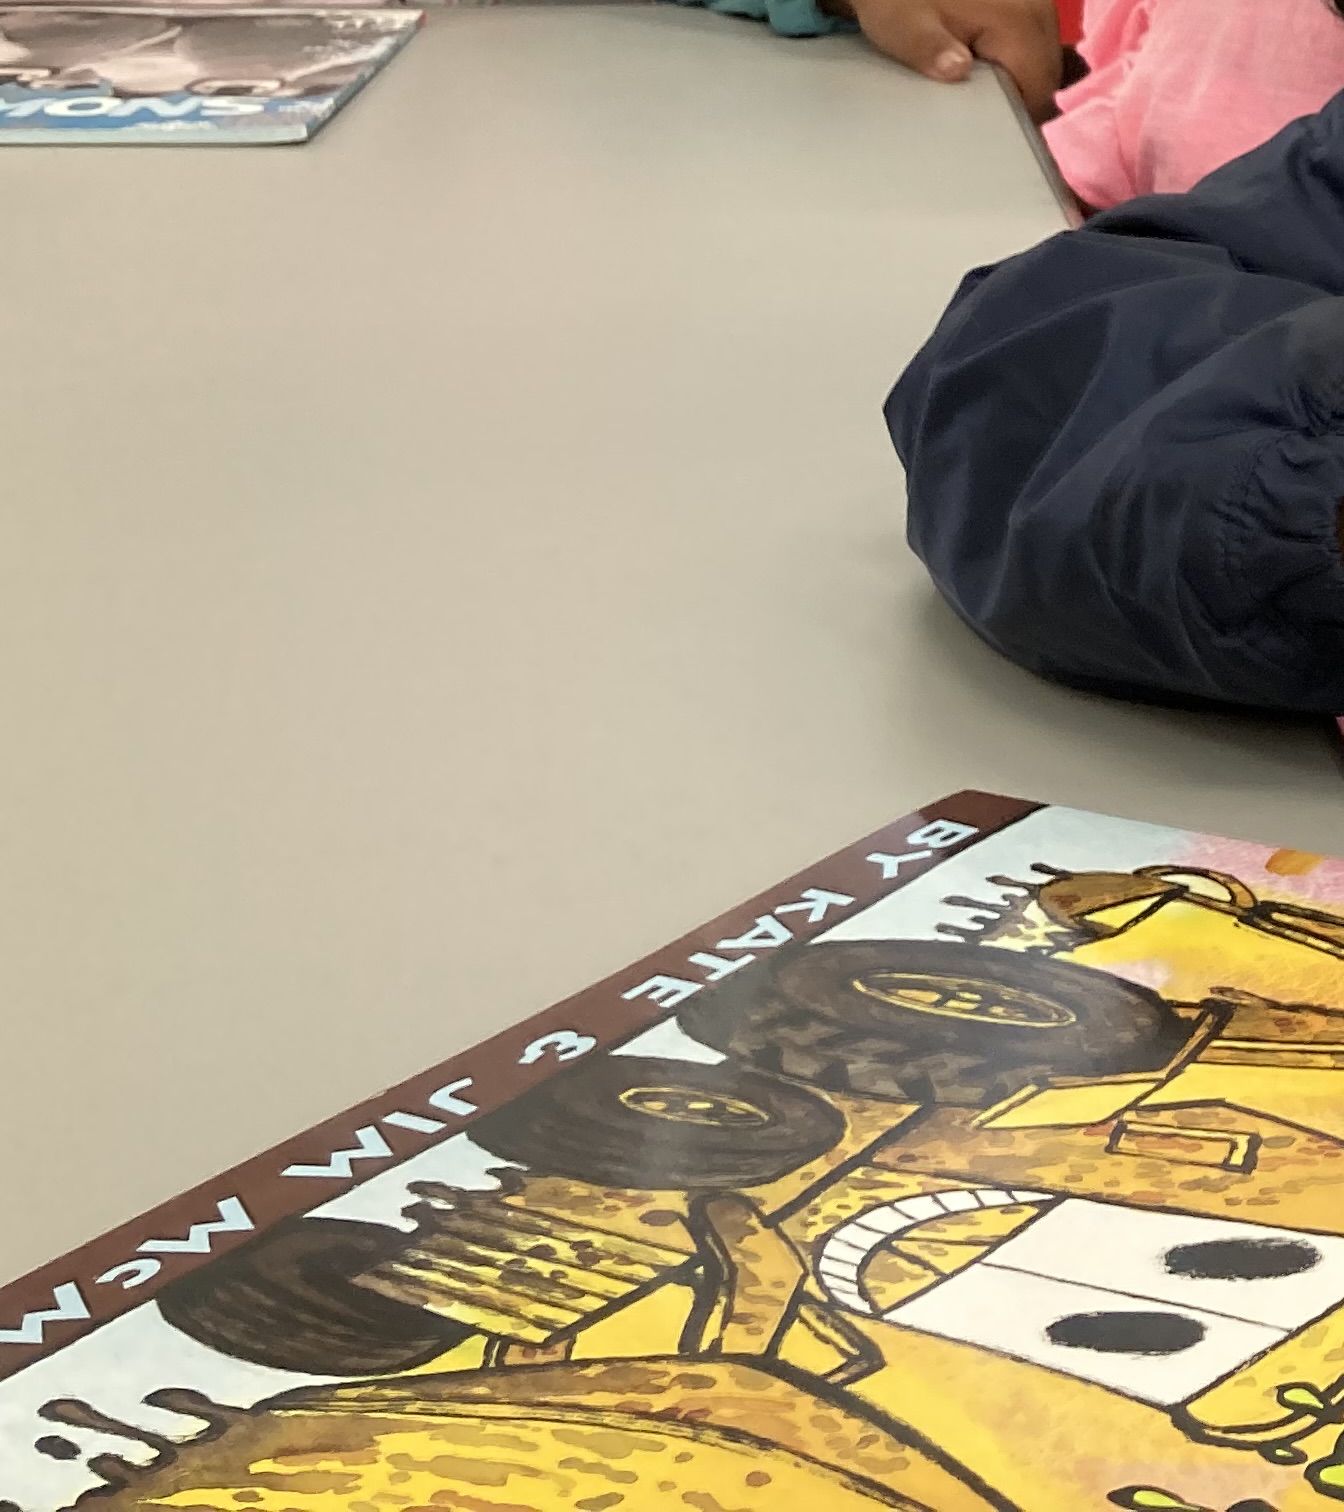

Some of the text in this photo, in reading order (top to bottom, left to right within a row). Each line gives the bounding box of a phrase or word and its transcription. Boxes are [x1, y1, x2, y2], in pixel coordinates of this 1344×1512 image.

[866, 816, 980, 882] BY
[620, 886, 857, 1013] KATE
[280, 1075, 479, 1188] JIM
